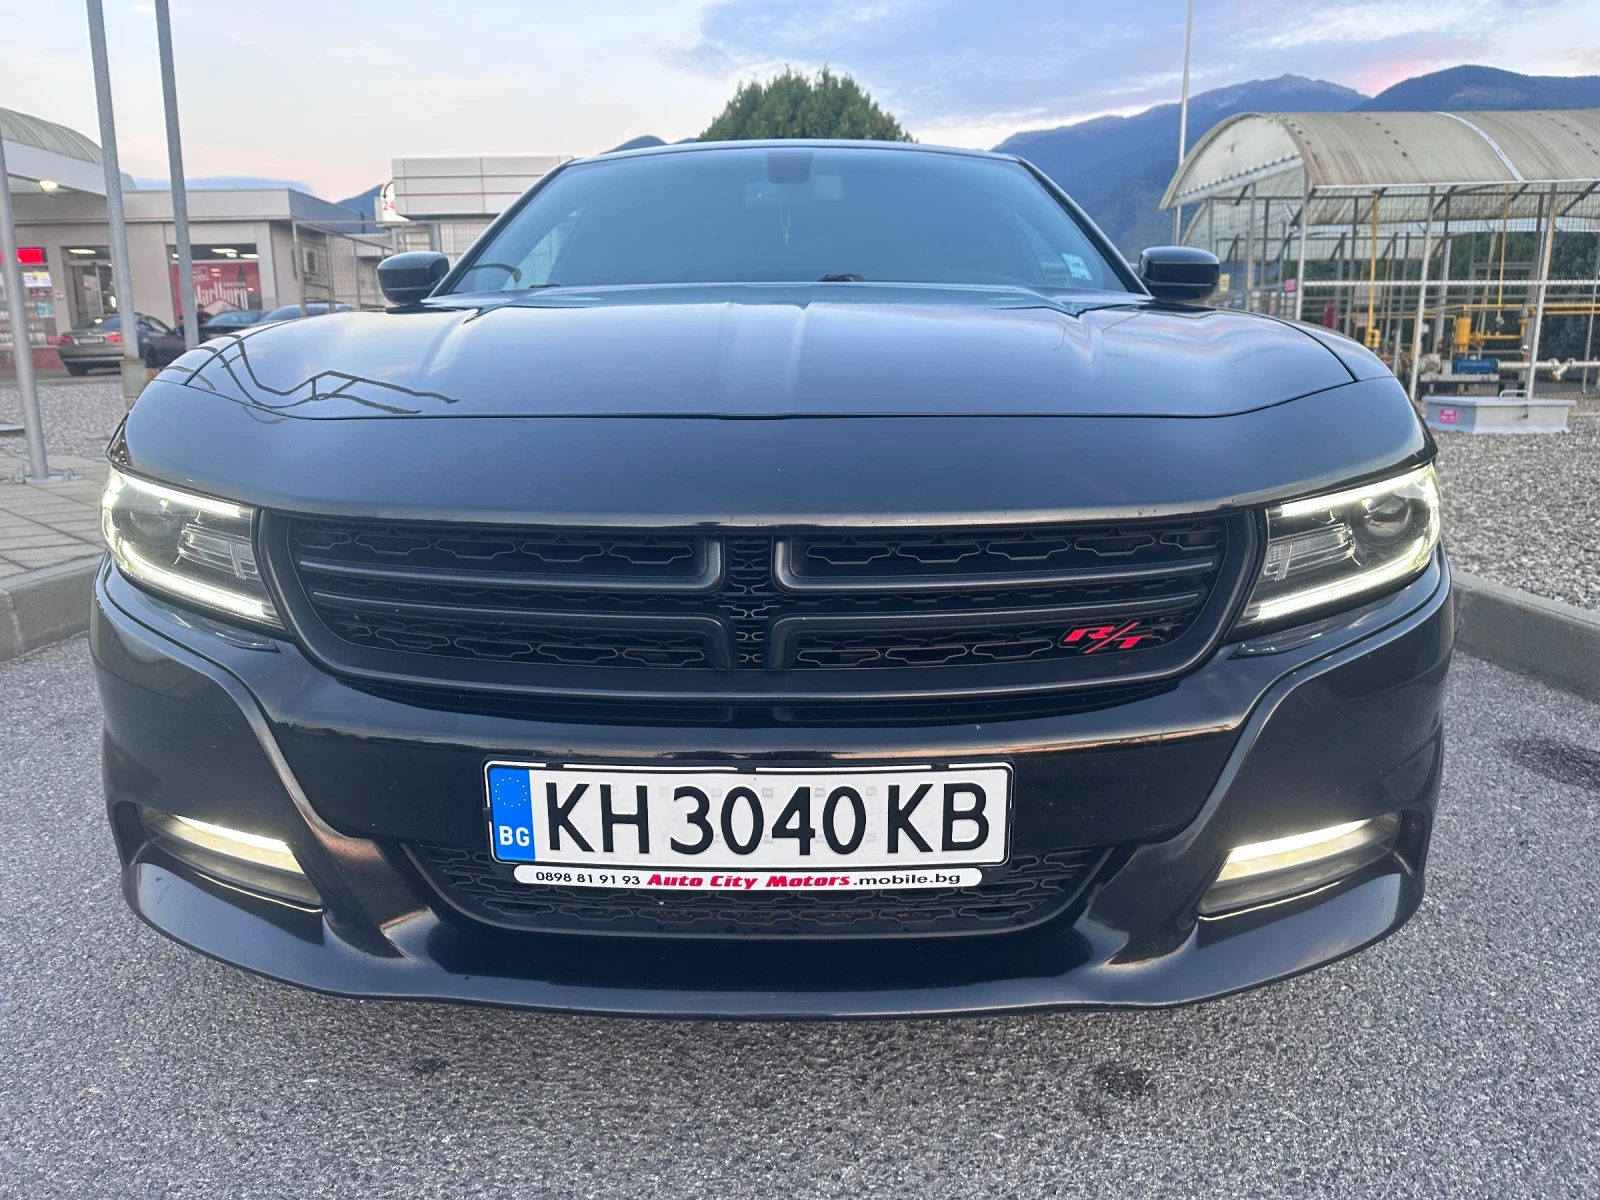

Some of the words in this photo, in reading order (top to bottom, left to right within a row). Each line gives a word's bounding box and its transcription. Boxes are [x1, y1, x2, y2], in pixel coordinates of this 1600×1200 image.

[545, 782, 650, 854] KH
[670, 785, 867, 856] 3040
[887, 782, 990, 853] KB
[498, 826, 530, 847] BG
[535, 871, 572, 882] 0898
[576, 873, 594, 884] 81
[600, 874, 617, 885] 91
[621, 875, 641, 885] 93
[646, 873, 704, 887] Auto
[709, 875, 759, 890] City
[765, 875, 851, 888] Motors
